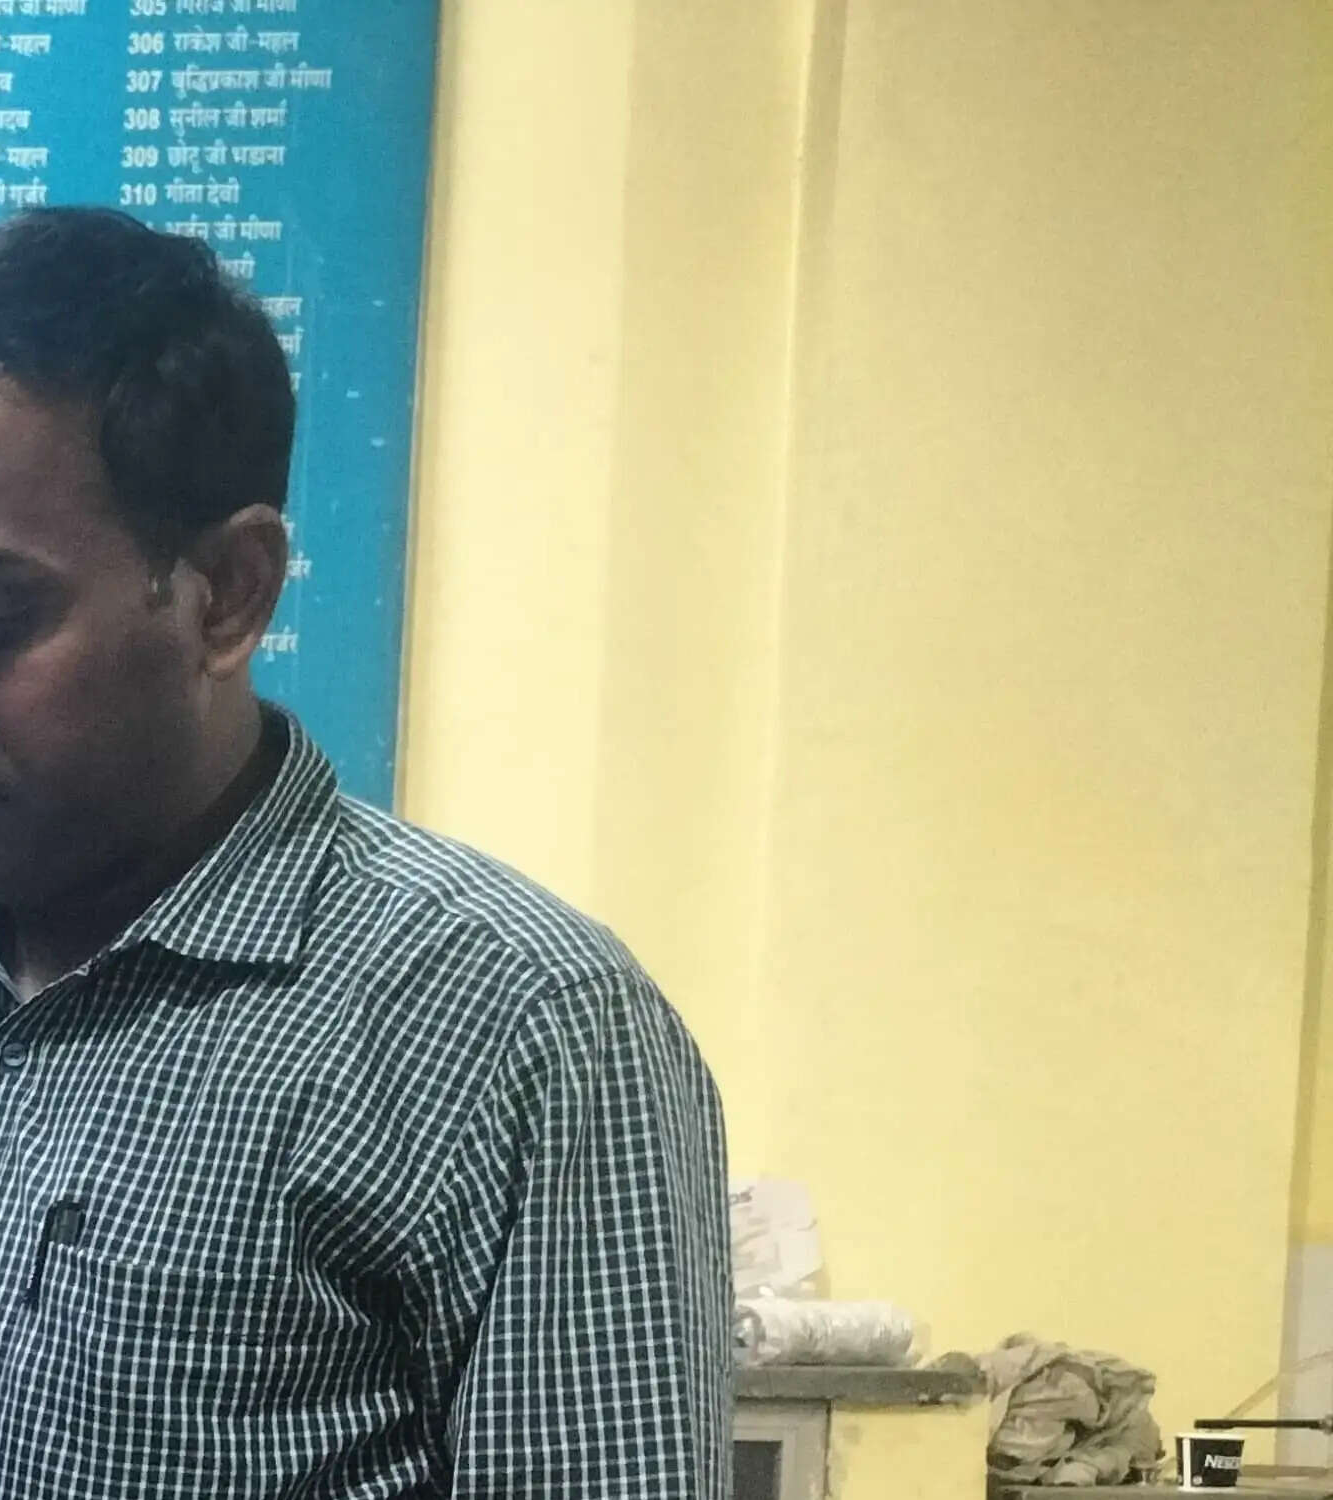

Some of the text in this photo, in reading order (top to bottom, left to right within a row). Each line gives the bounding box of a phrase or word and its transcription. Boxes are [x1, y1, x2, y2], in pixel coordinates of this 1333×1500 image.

[128, 32, 164, 54] 306
[126, 70, 162, 92] 307
[264, 63, 287, 88] जी
[124, 108, 160, 130] 308
[223, 102, 248, 126] जी
[122, 146, 159, 167] 309
[204, 140, 227, 164] जी
[120, 184, 157, 205] 310
[213, 215, 237, 240] जी
